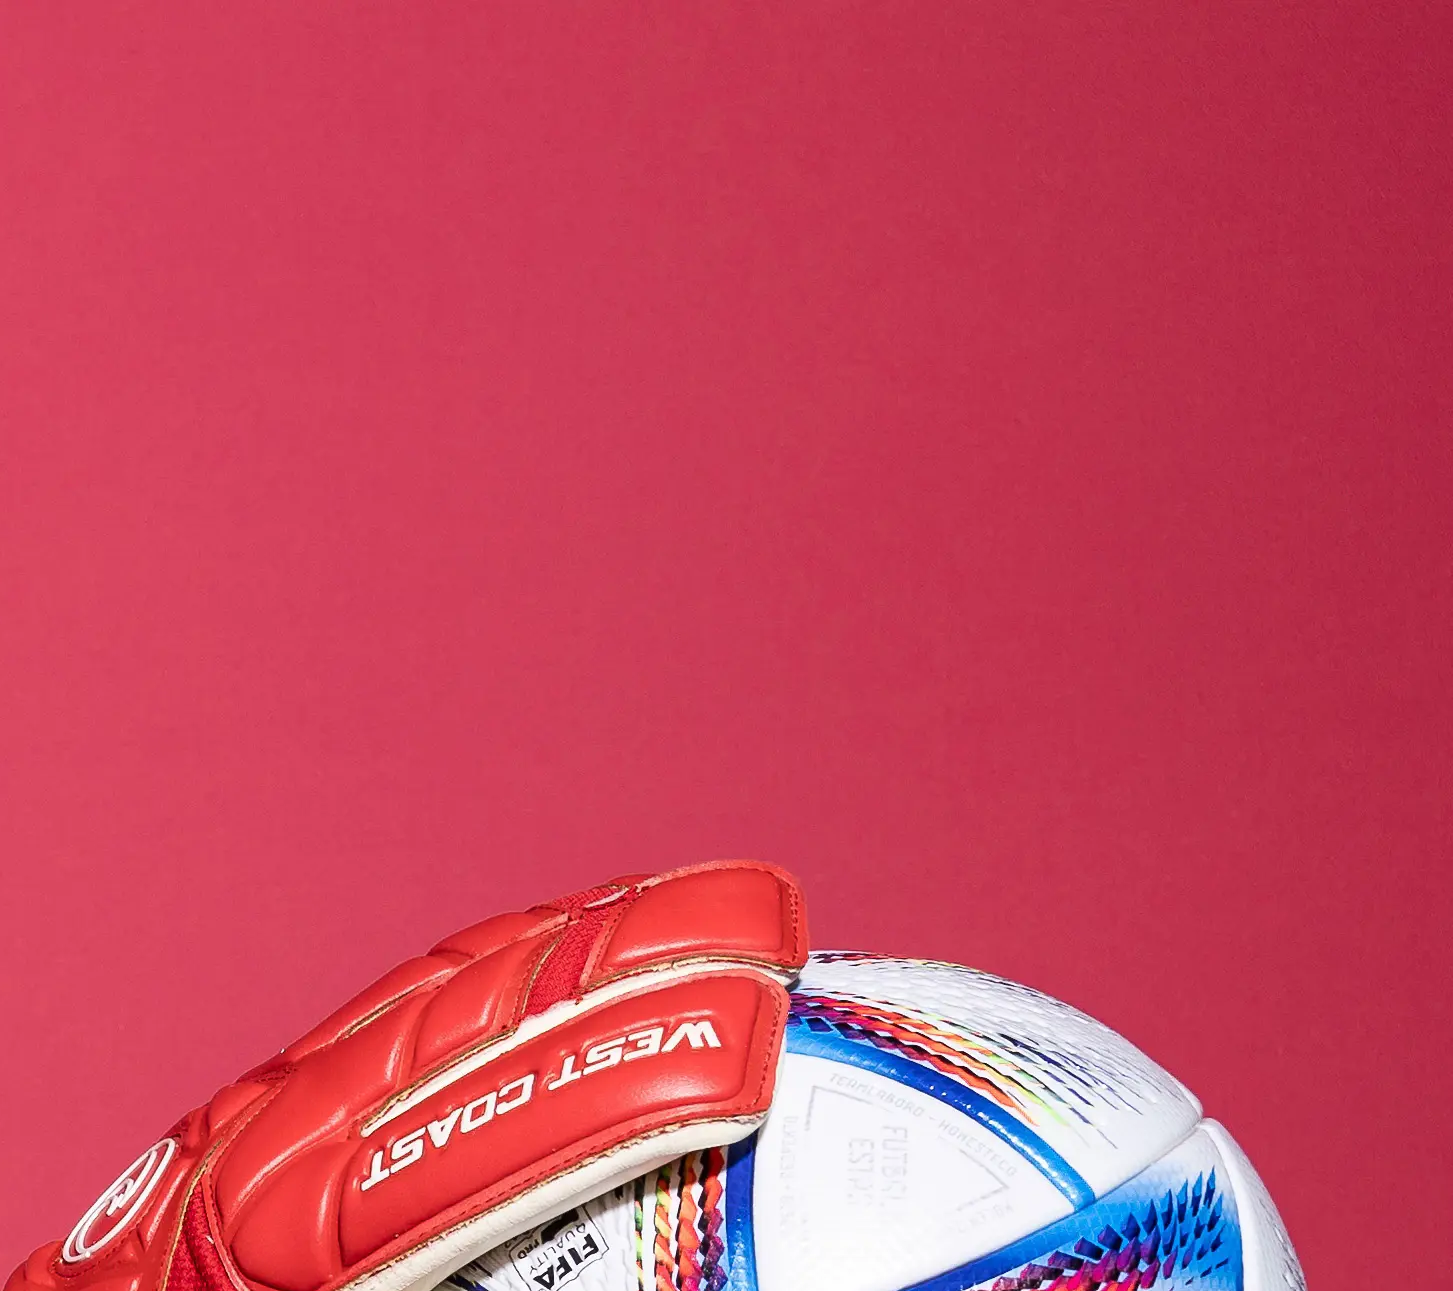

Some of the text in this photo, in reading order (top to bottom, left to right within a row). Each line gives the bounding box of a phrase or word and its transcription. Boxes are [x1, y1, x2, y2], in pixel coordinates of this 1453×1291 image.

[360, 1021, 722, 1191] WEST COAST
[529, 1222, 586, 1275] QUALITY
[533, 1233, 599, 1290] FIFA
